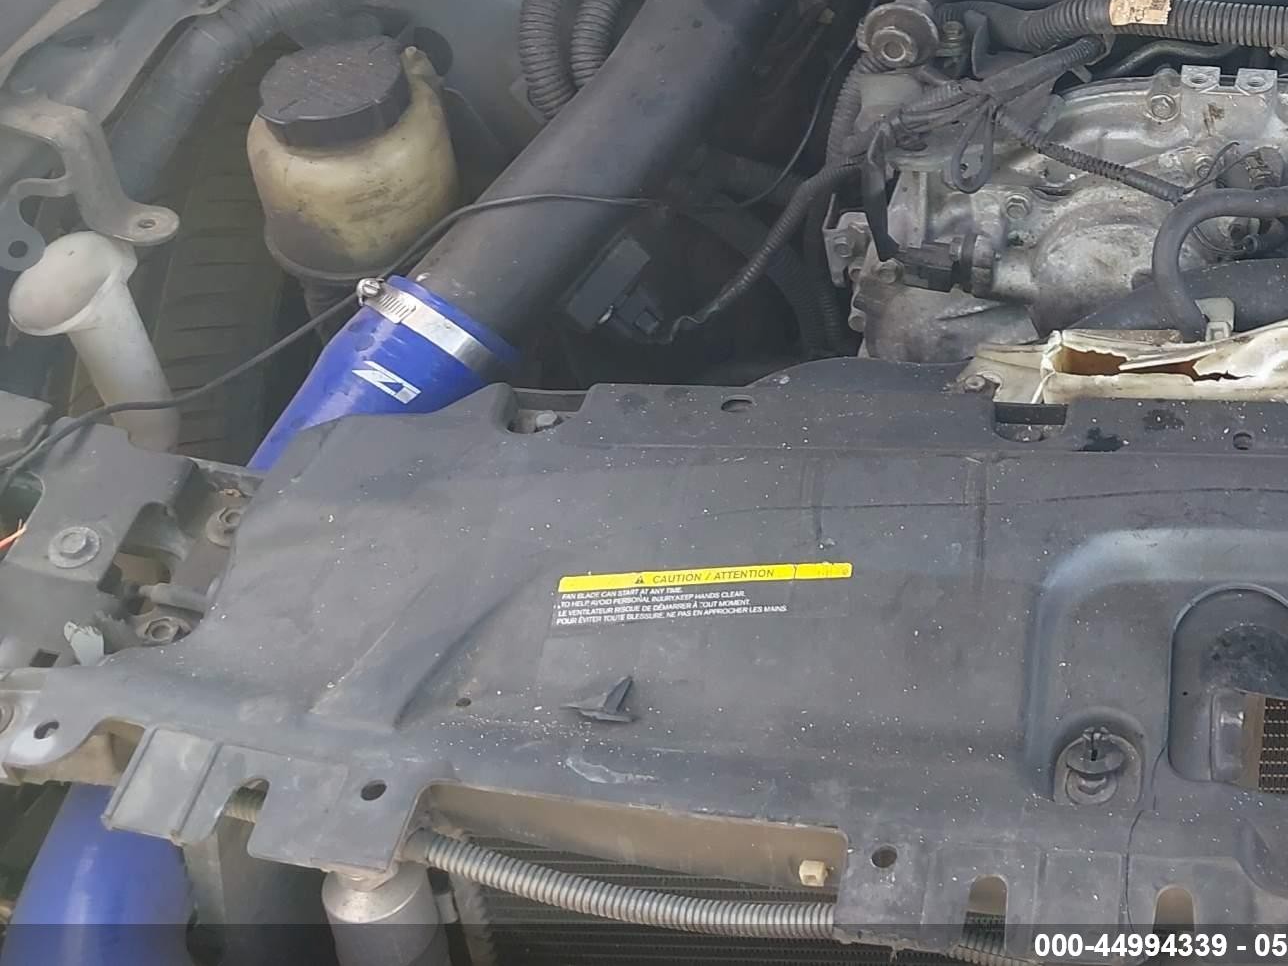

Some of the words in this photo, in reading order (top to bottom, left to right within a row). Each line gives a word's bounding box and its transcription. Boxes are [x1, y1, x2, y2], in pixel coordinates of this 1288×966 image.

[652, 574, 702, 584] CAUTION
[713, 569, 775, 579] ATTENTION
[562, 592, 576, 600] FAN
[577, 591, 600, 599] BLADE
[601, 590, 617, 598] CAN
[617, 588, 640, 597] START
[650, 587, 664, 595] ANY
[590, 598, 612, 606] AVOID
[613, 595, 650, 605] PERSONAL
[694, 591, 721, 600] HANDS
[556, 617, 578, 625] POUR
[578, 615, 602, 624] ÉVITER
[603, 614, 626, 622] TOUTE
[677, 609, 692, 617] PAS
[703, 606, 748, 615] APPROCHER
[749, 605, 763, 613] LES
[569, 607, 614, 616] VENTILATEUR
[614, 606, 641, 614] RISQUE
[641, 604, 652, 612] DE
[652, 601, 692, 612] DÉMARRER
[692, 599, 698, 608] À
